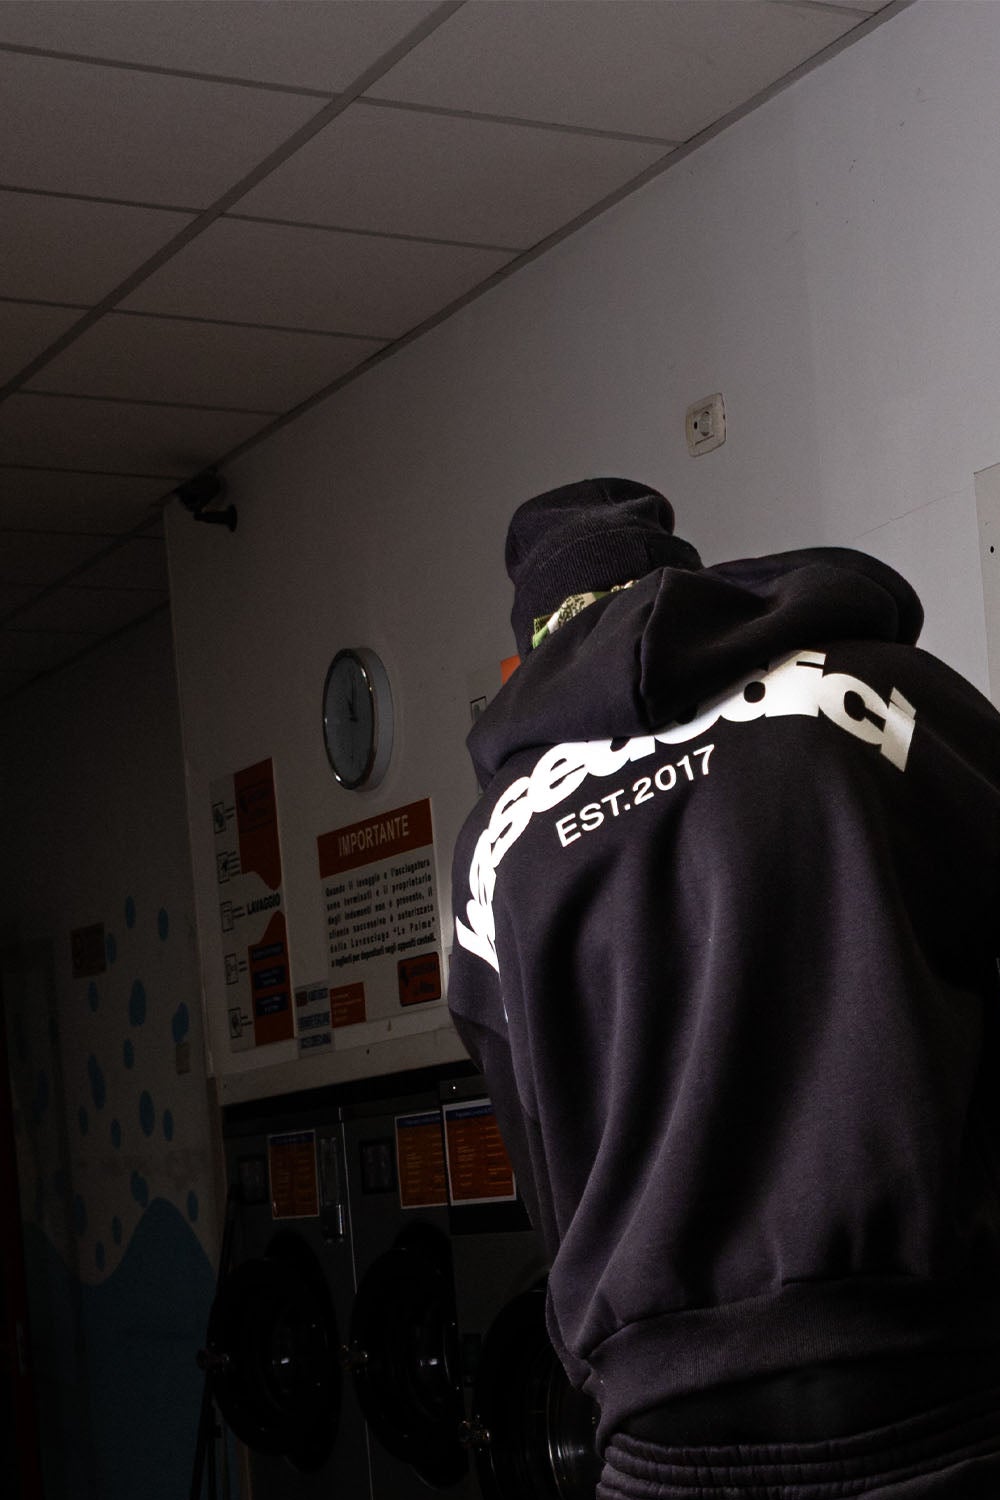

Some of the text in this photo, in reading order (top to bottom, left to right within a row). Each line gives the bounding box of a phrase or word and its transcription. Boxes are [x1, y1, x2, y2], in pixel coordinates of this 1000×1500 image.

[555, 744, 715, 847] EST.2017
[337, 814, 410, 856] IMPORTANTE
[247, 893, 280, 915] LAVAGGIO
